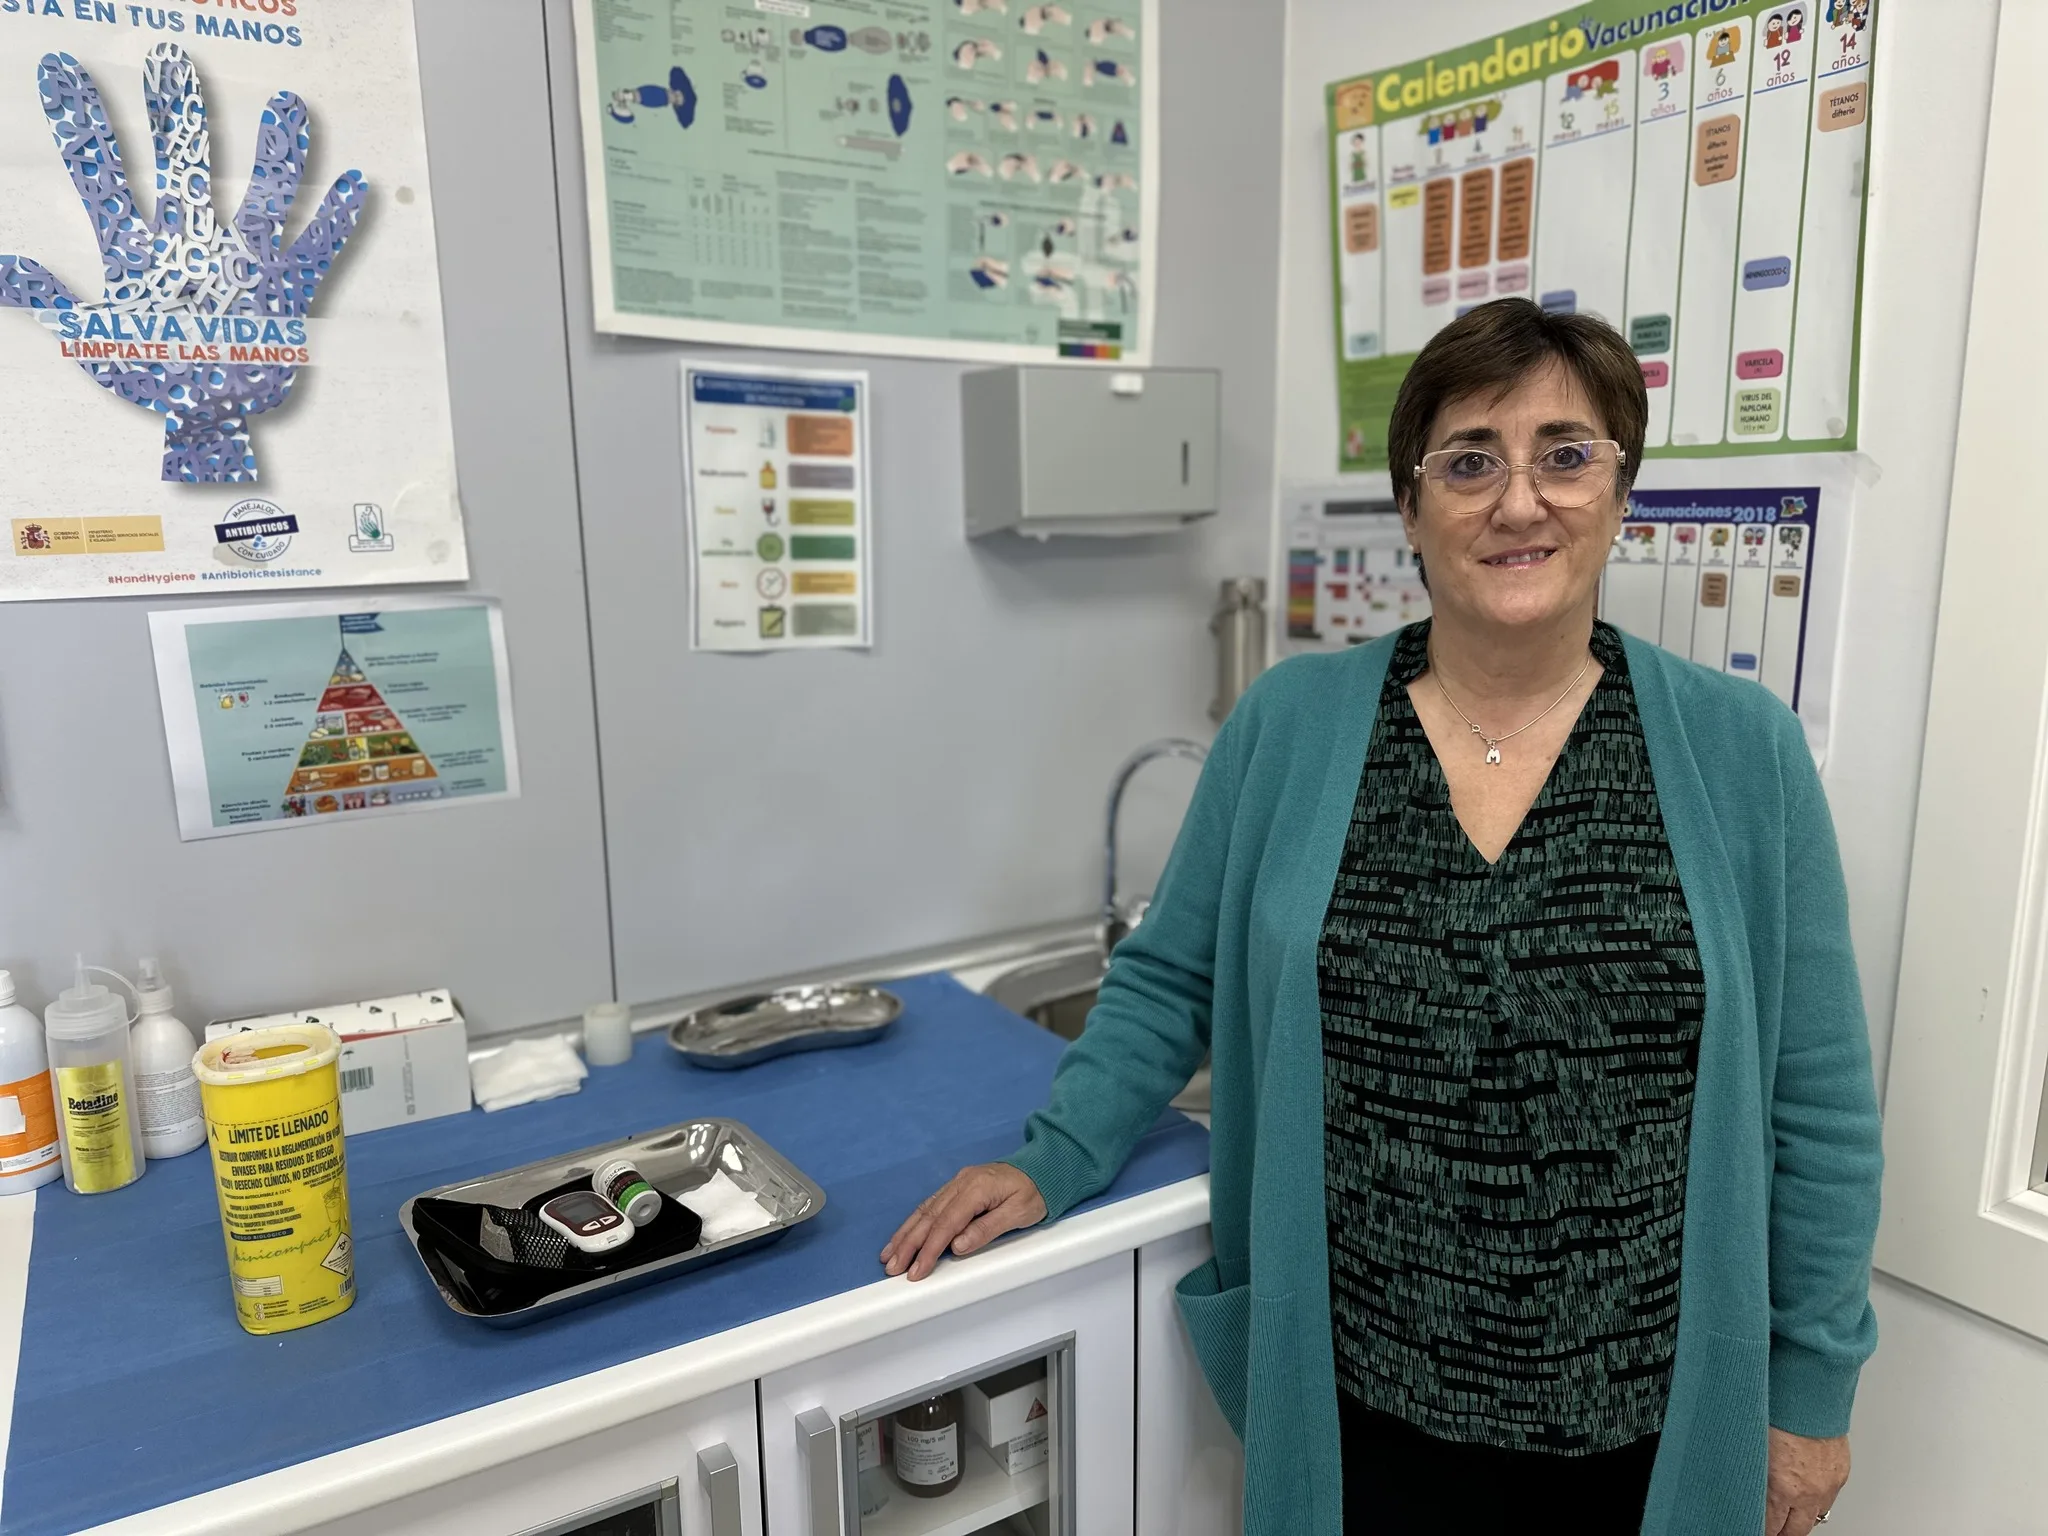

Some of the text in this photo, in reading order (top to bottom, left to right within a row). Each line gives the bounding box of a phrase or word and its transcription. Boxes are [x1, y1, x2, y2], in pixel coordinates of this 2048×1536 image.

[73, 0, 117, 24] EN
[125, 5, 185, 32] TUS
[195, 14, 303, 47] MANOS
[1840, 33, 1857, 53] 14
[1377, 20, 1586, 112] Calendario
[1773, 49, 1791, 71] 12
[1832, 54, 1861, 70] años
[1715, 68, 1726, 87] 6
[1766, 72, 1796, 87] años
[1658, 82, 1670, 101] 3
[1707, 88, 1733, 102] años
[1829, 93, 1859, 108] TÉTANOS
[1650, 103, 1676, 117] años
[1831, 107, 1856, 119] difteria
[59, 311, 307, 345] SALVA VIDAS
[179, 344, 220, 360] LAS
[230, 346, 309, 363] MANOS
[1745, 357, 1773, 367] VARICELA
[1742, 393, 1773, 402] VIRUS DEL
[1740, 403, 1772, 412] PAPILOMA
[1740, 414, 1771, 423] HUMANO
[232, 503, 276, 519] MANÉJALOS
[1632, 502, 1776, 523] Vacunaciones 2018
[225, 520, 290, 539] ANTIBIÓTICOS
[237, 541, 285, 559] CON CUIDADO
[108, 567, 322, 584] #HandHygiene #AntibioticResistance
[68, 1092, 119, 1110] Betadine
[229, 1110, 329, 1144] LÍMITE DE LLENADO
[239, 1147, 268, 1162] CONFORME
[268, 1147, 273, 1158] A
[274, 1146, 281, 1157] LA
[281, 1131, 325, 1154] REGLAMENTACIÓN
[232, 1144, 335, 1177] ENVASES PARA RESIDUOS DE RIESGO
[234, 1177, 262, 1191] DESECHOS
[264, 1172, 293, 1188] CLÍNICOS,
[292, 1170, 301, 1181] NO
